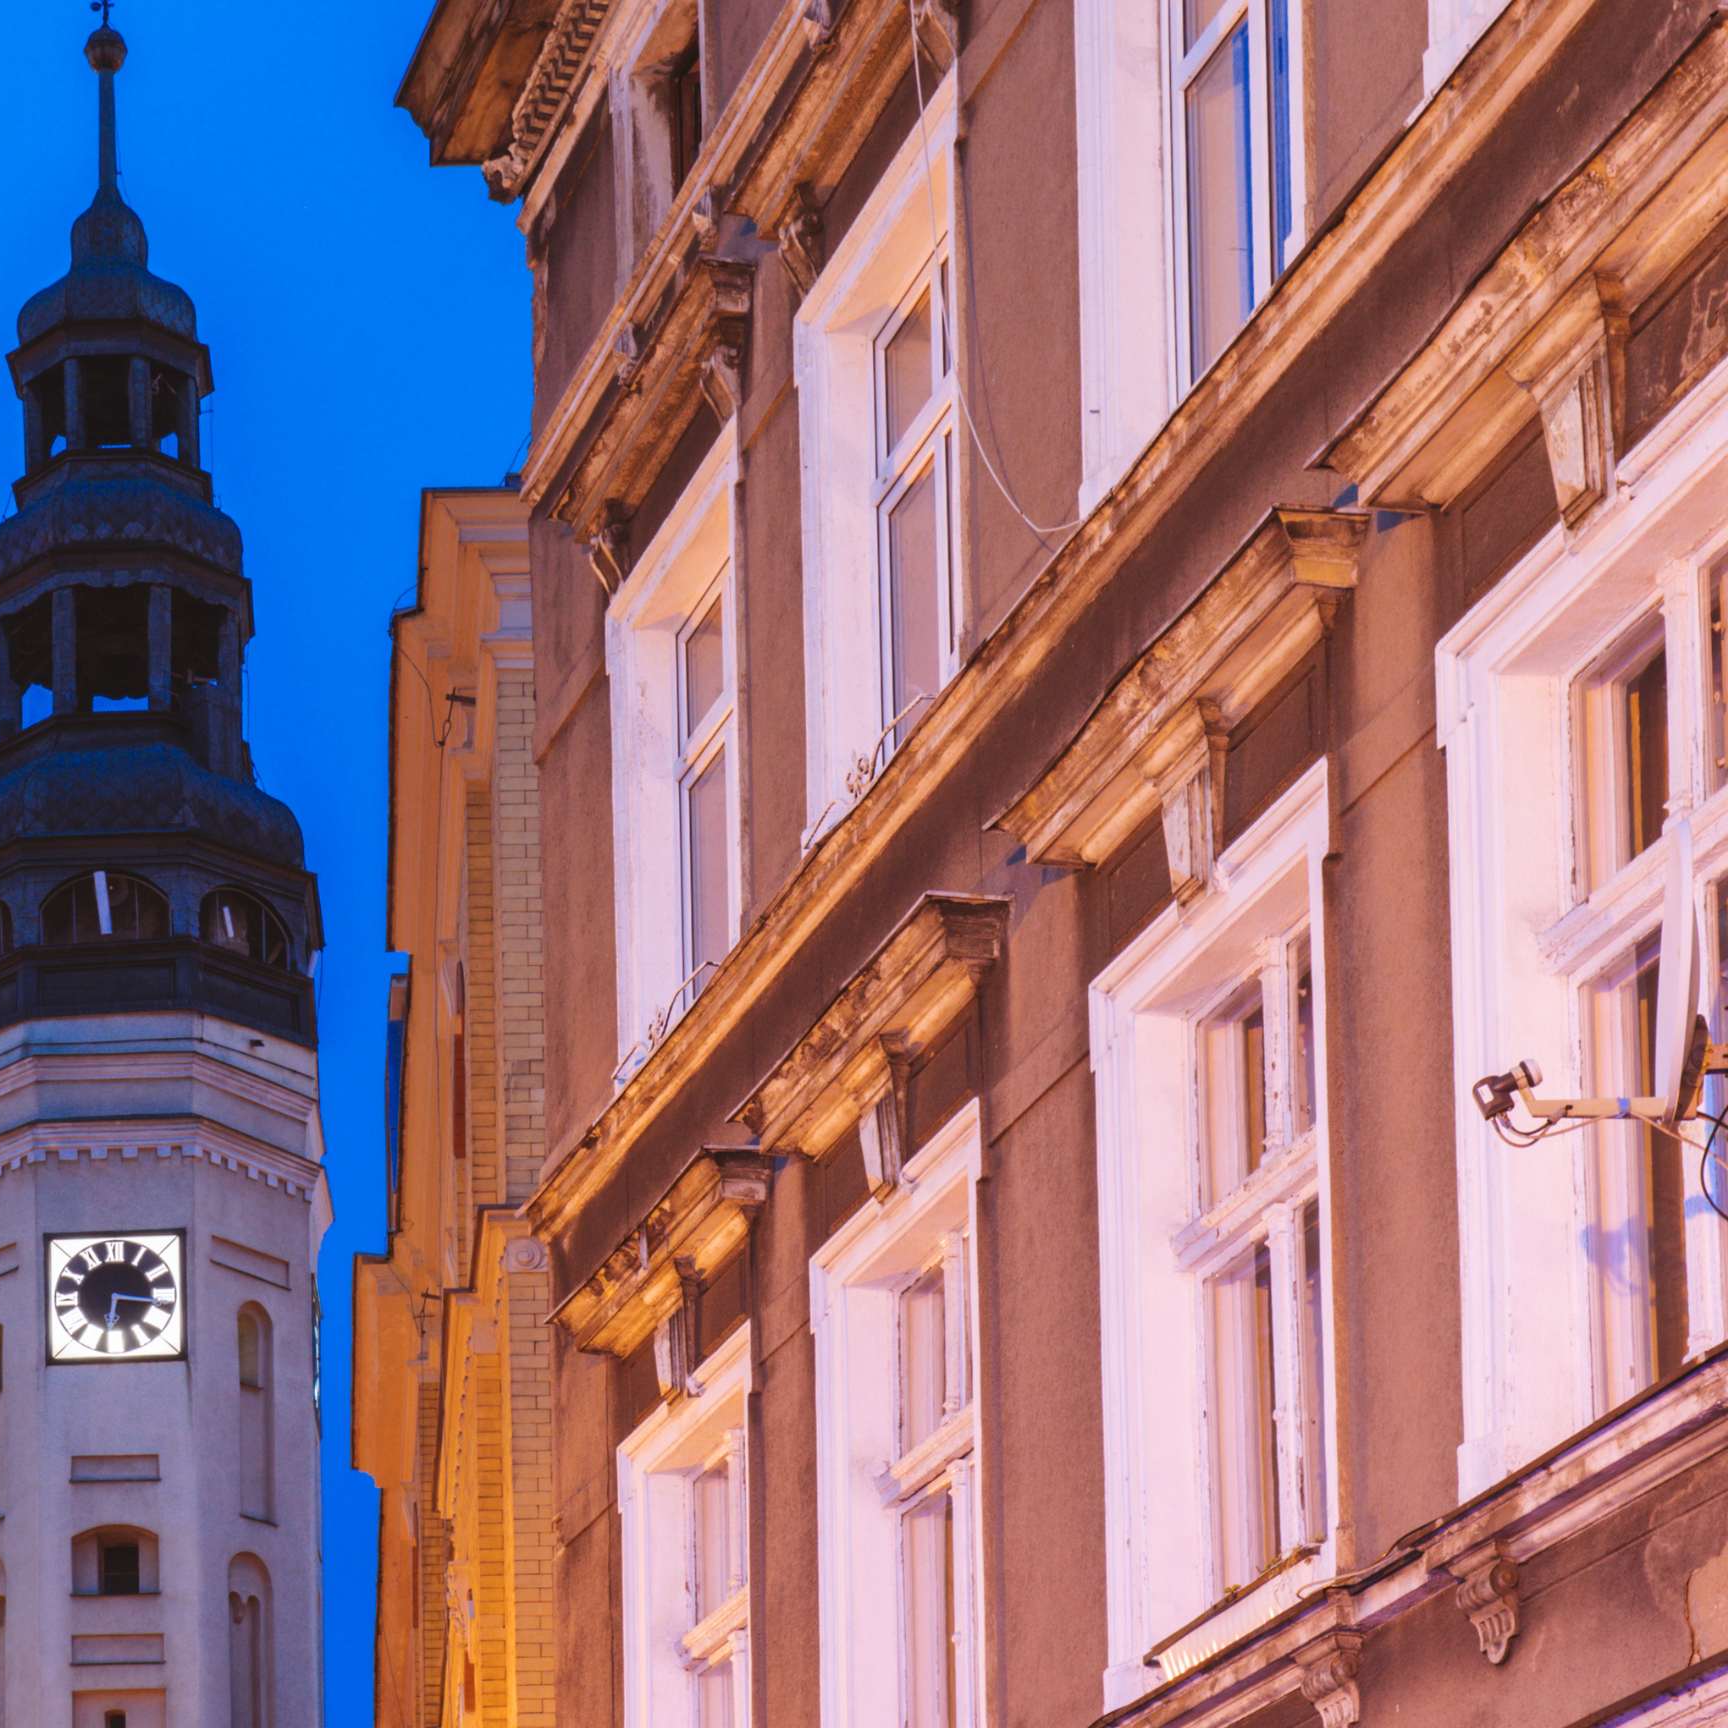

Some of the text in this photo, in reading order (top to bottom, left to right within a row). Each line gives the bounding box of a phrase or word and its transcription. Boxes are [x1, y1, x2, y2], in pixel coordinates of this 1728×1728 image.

[80, 1247, 102, 1270] XI
[105, 1242, 124, 1262] XII
[132, 1246, 147, 1266] I
[61, 1267, 85, 1285] X
[145, 1263, 168, 1282] II
[56, 1291, 78, 1306] IX
